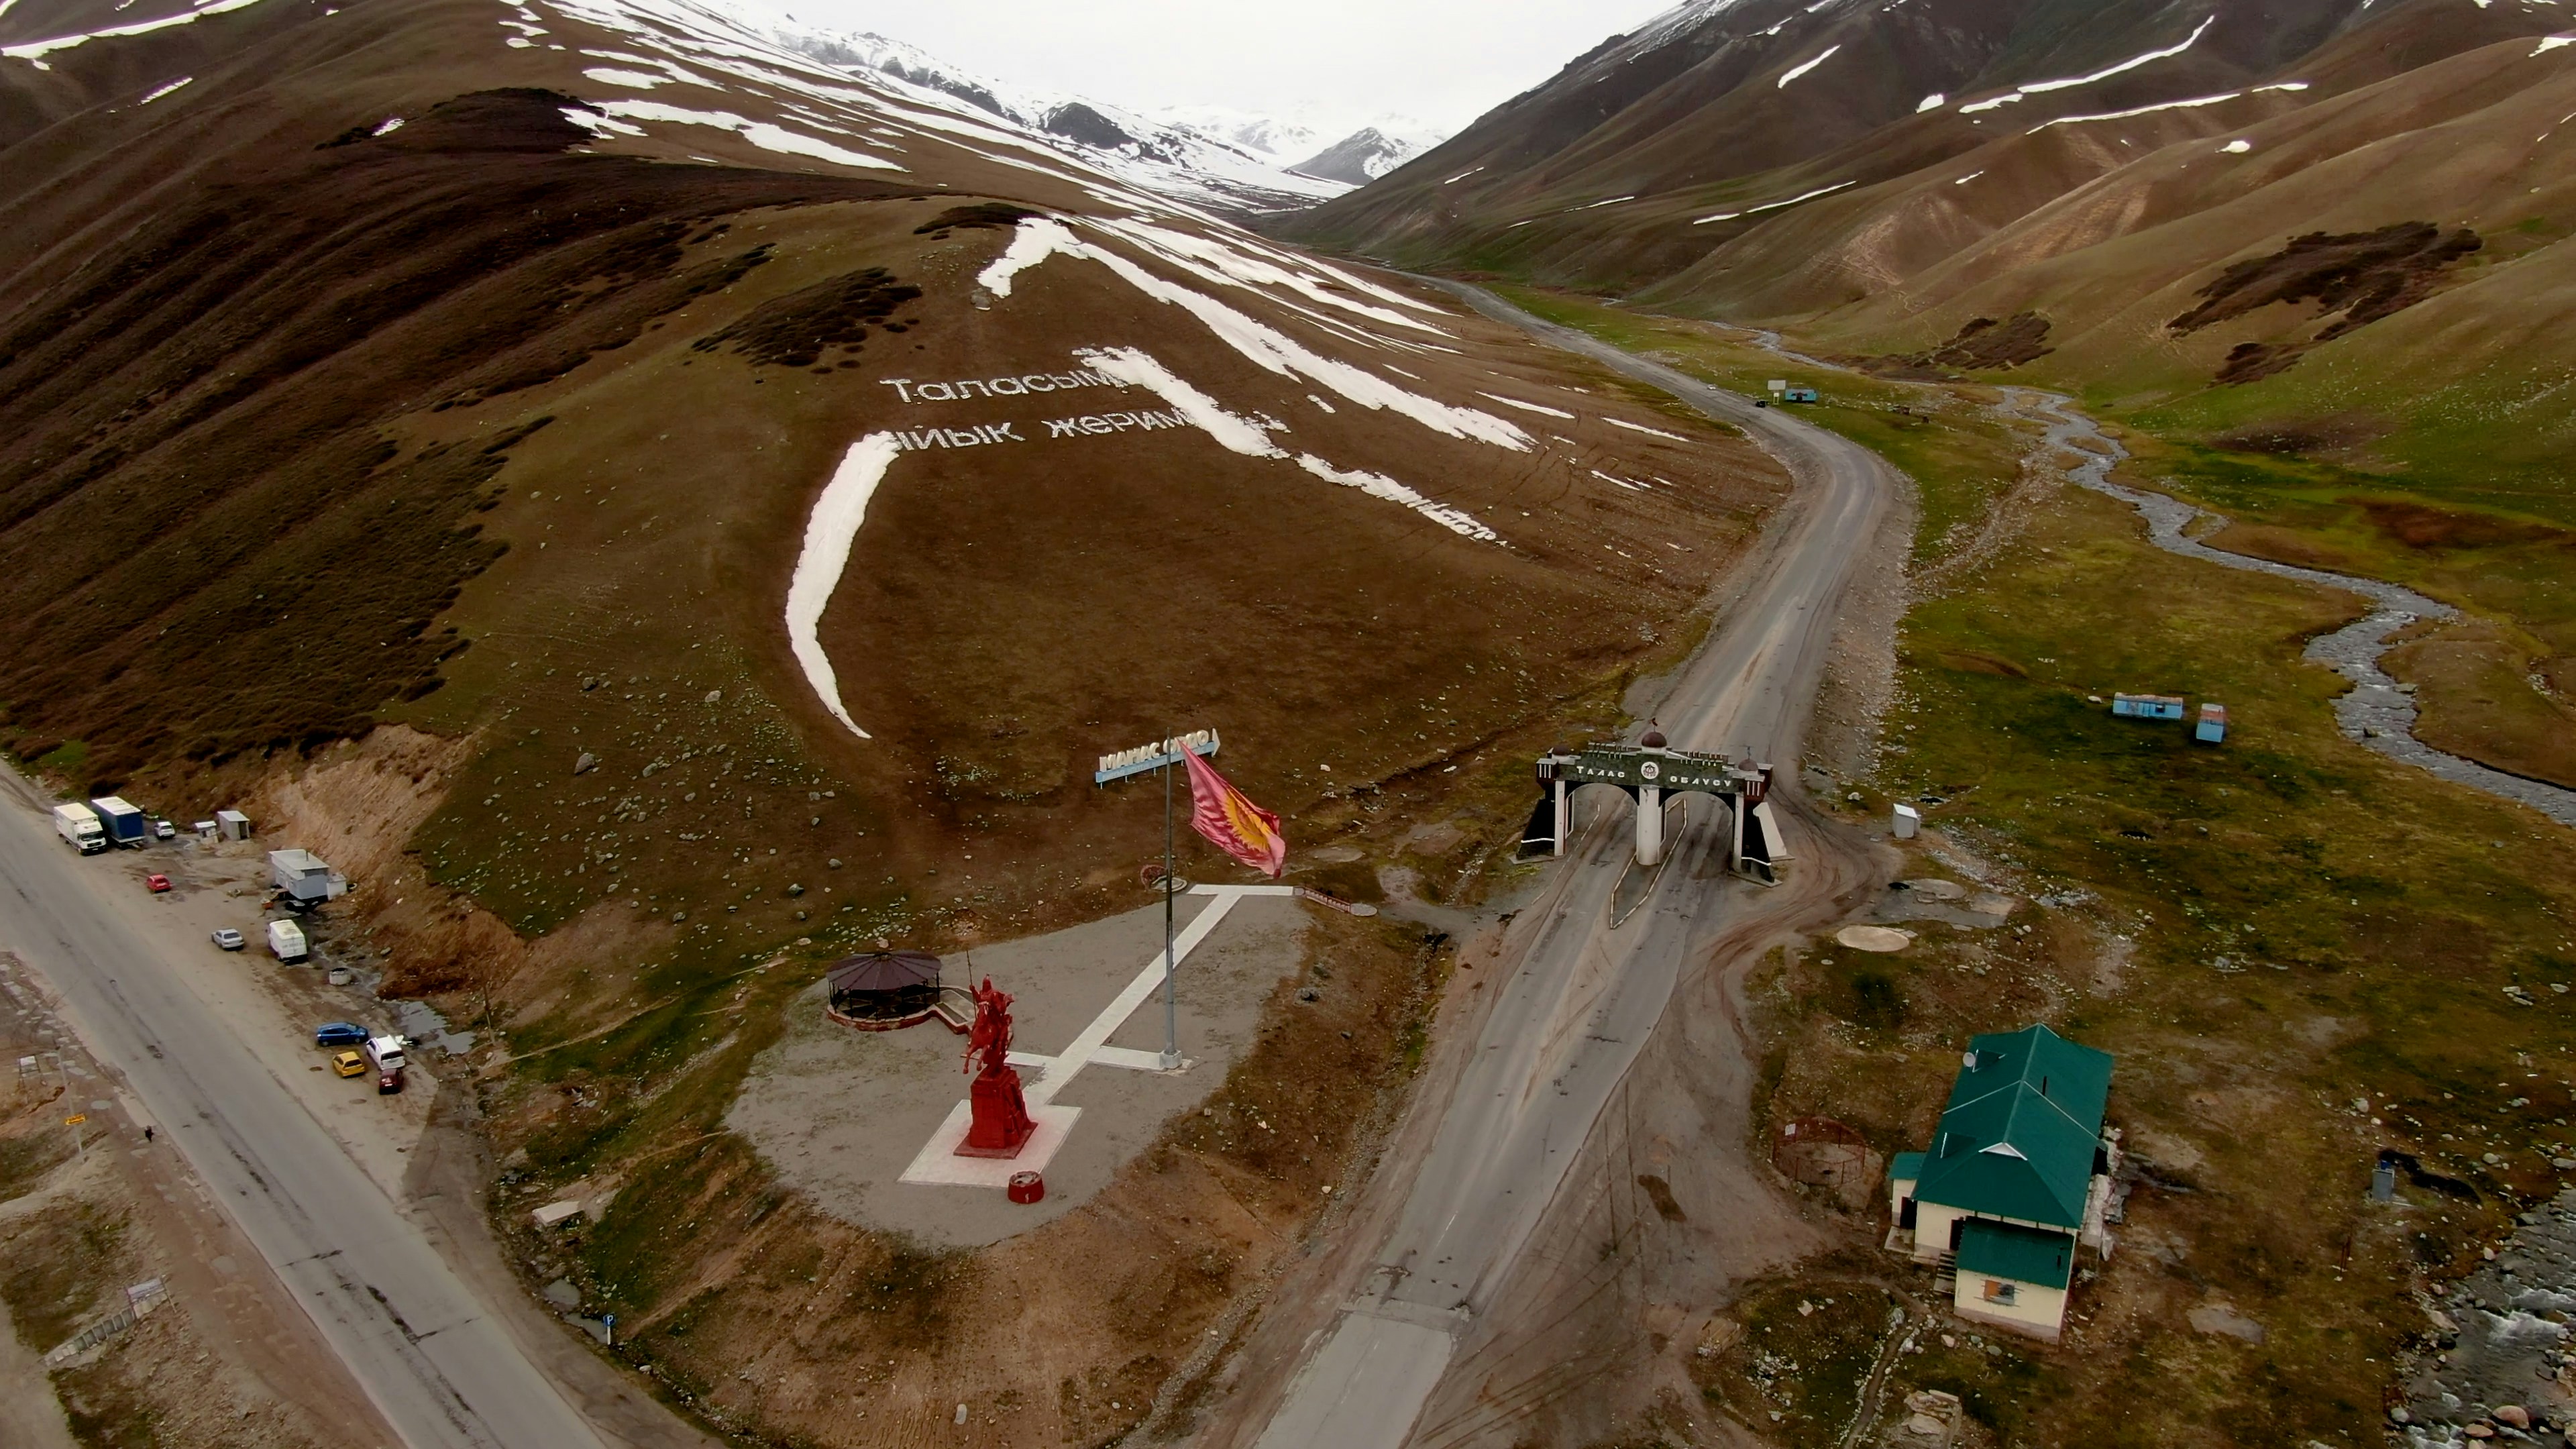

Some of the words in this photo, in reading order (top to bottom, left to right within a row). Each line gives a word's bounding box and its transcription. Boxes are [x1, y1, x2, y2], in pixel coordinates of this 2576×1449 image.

[1099, 742, 1160, 771] МАНАС
[1576, 765, 1625, 778] ТАЛАС
[1670, 775, 1731, 787] ОБЛУСУ
